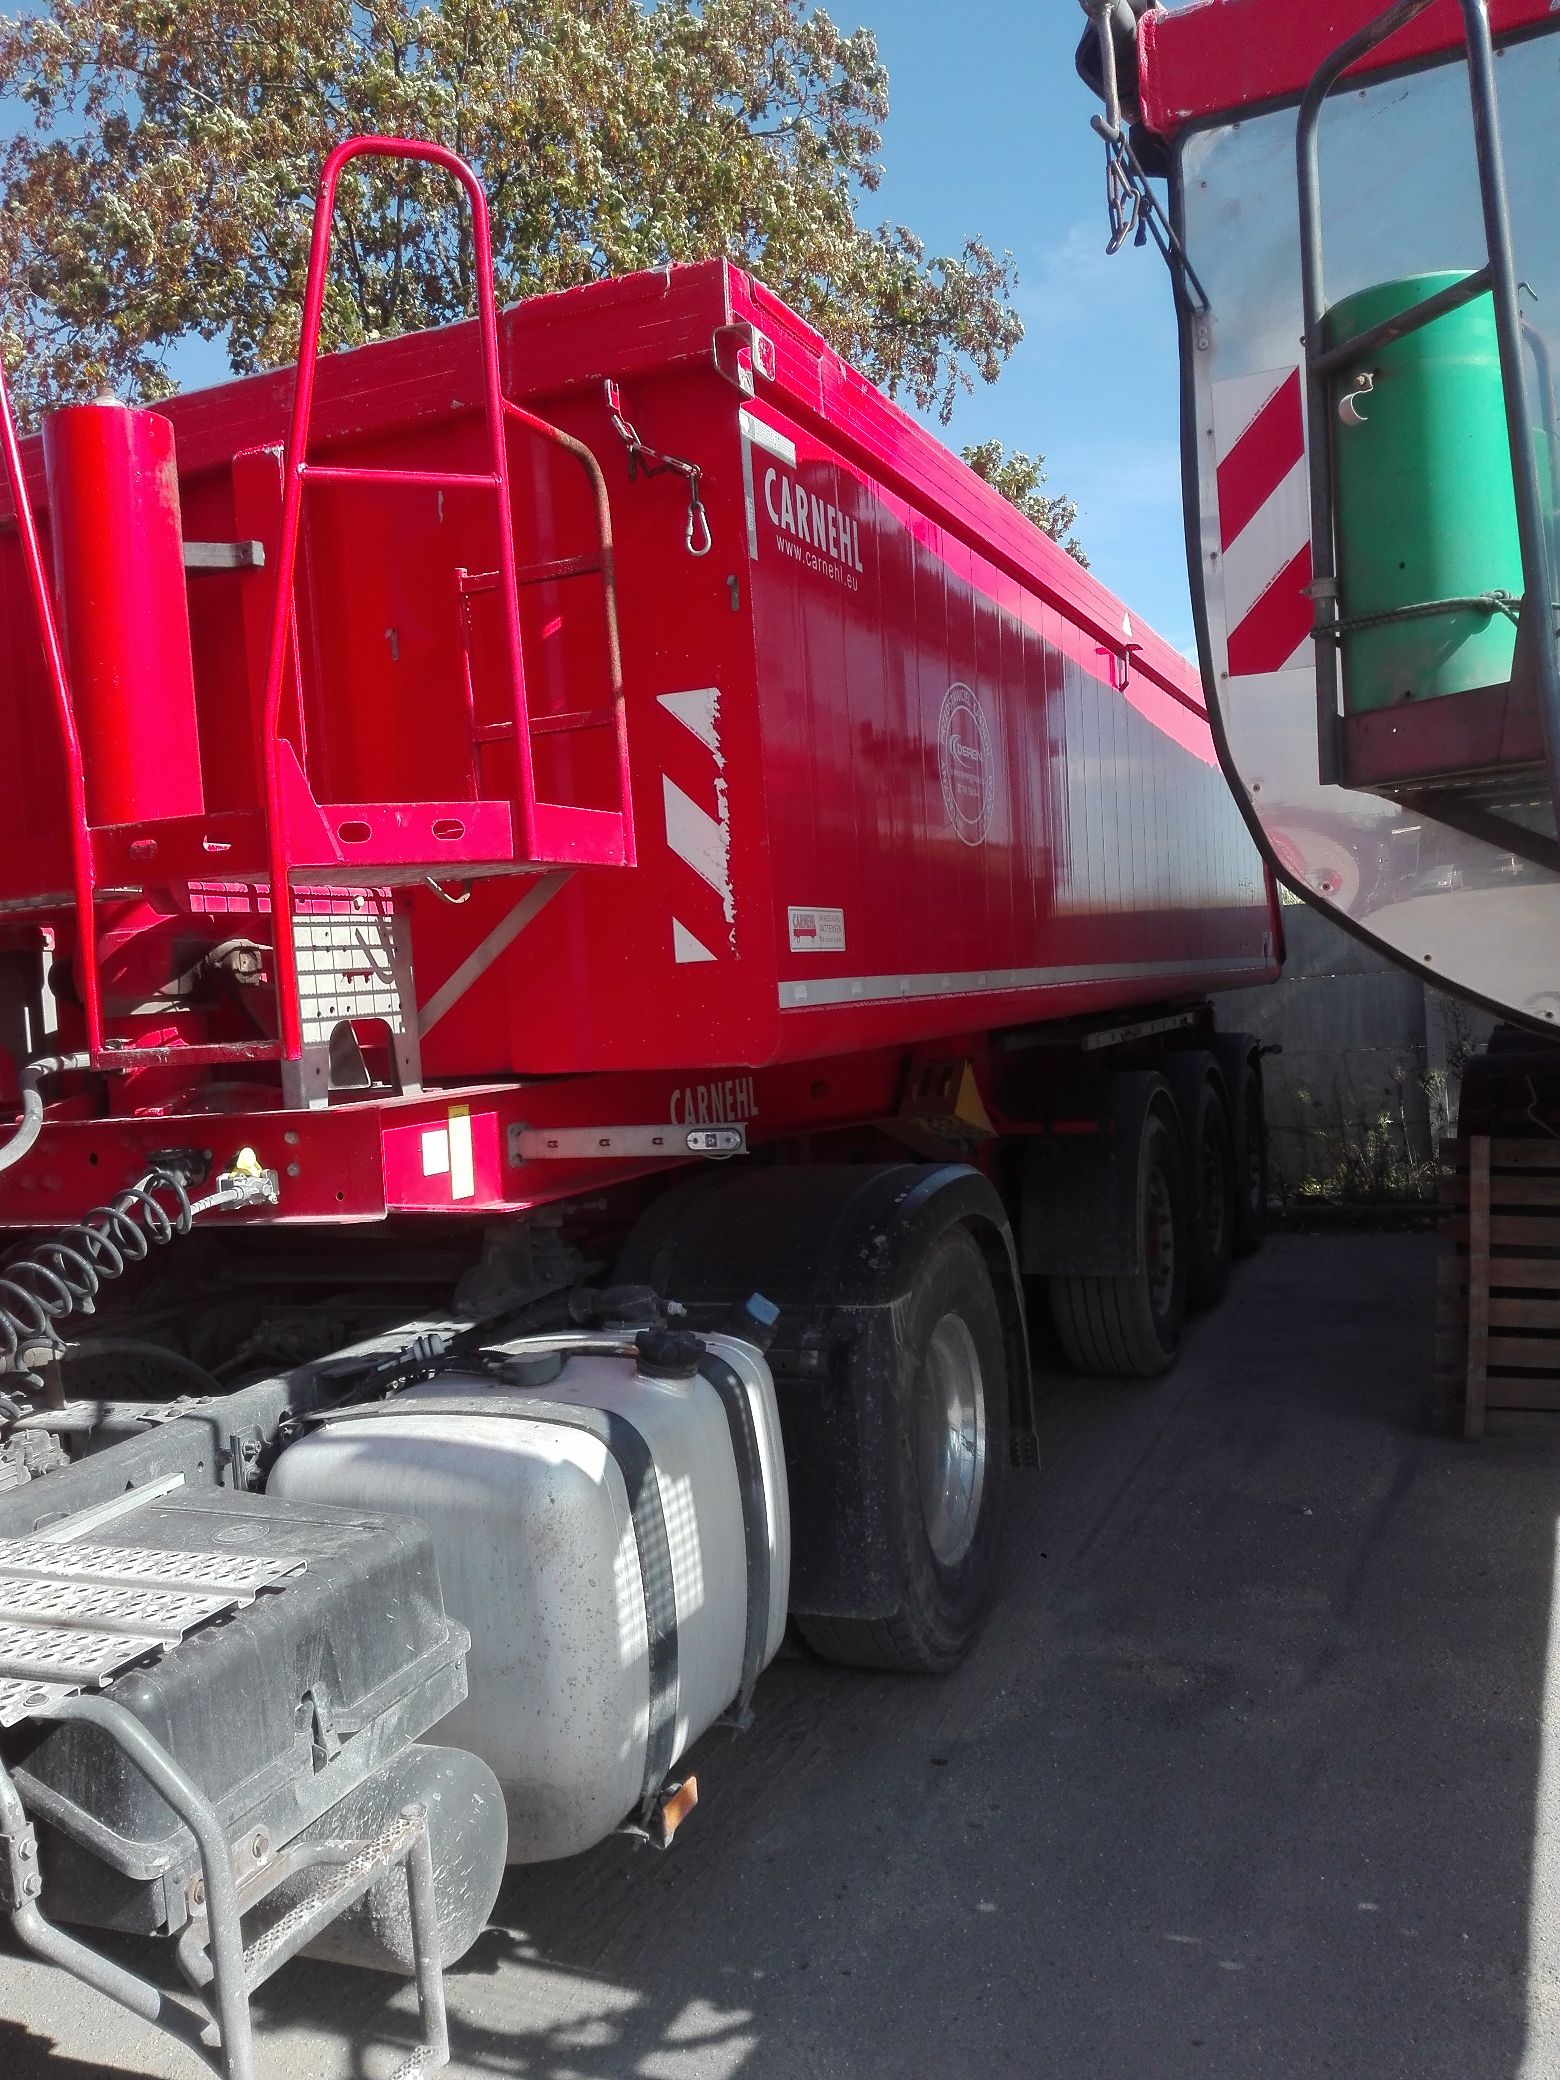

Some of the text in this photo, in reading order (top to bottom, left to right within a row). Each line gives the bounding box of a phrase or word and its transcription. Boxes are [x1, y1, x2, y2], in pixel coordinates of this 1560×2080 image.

[764, 467, 864, 573] CARNEHL
[775, 534, 859, 592] www.carnehl.eu
[670, 1076, 759, 1126] CARNEHL
